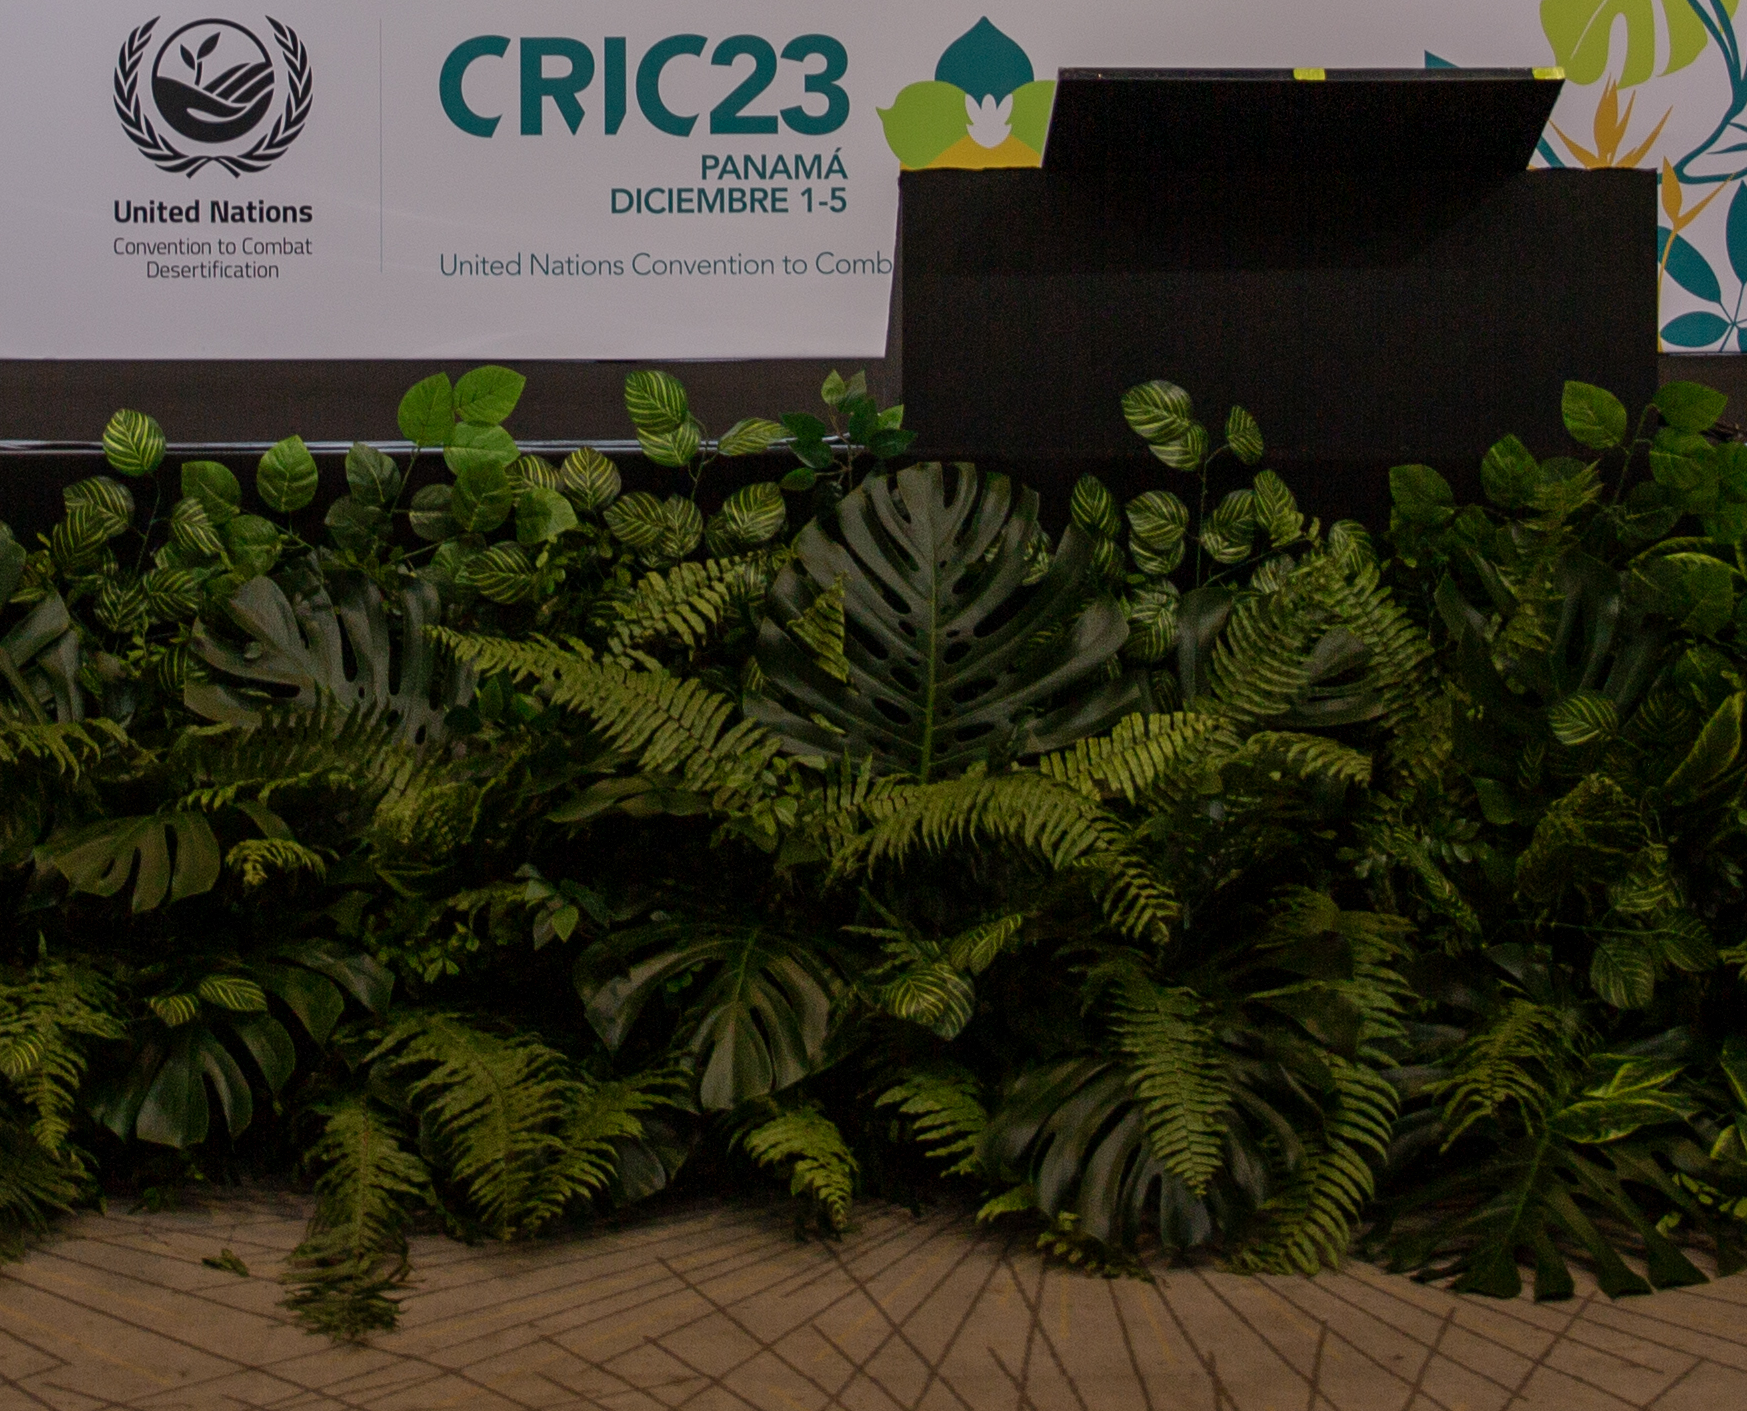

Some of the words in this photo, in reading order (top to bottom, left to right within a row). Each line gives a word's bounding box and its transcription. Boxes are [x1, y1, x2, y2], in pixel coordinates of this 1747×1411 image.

[439, 34, 849, 137] CRIC23
[702, 148, 848, 180] PANAMÁ
[115, 200, 199, 223] United
[211, 200, 312, 223] Nations
[612, 188, 788, 214] DICIEMBRE
[801, 187, 846, 213] 1-5
[114, 237, 210, 255] Convention
[218, 239, 236, 255] to
[242, 237, 312, 255] Combat
[147, 260, 279, 278] Desertification
[441, 252, 521, 276] United
[531, 253, 624, 275] Nations
[632, 253, 774, 275] Convention
[783, 256, 807, 274] to
[816, 251, 893, 275] Comb
